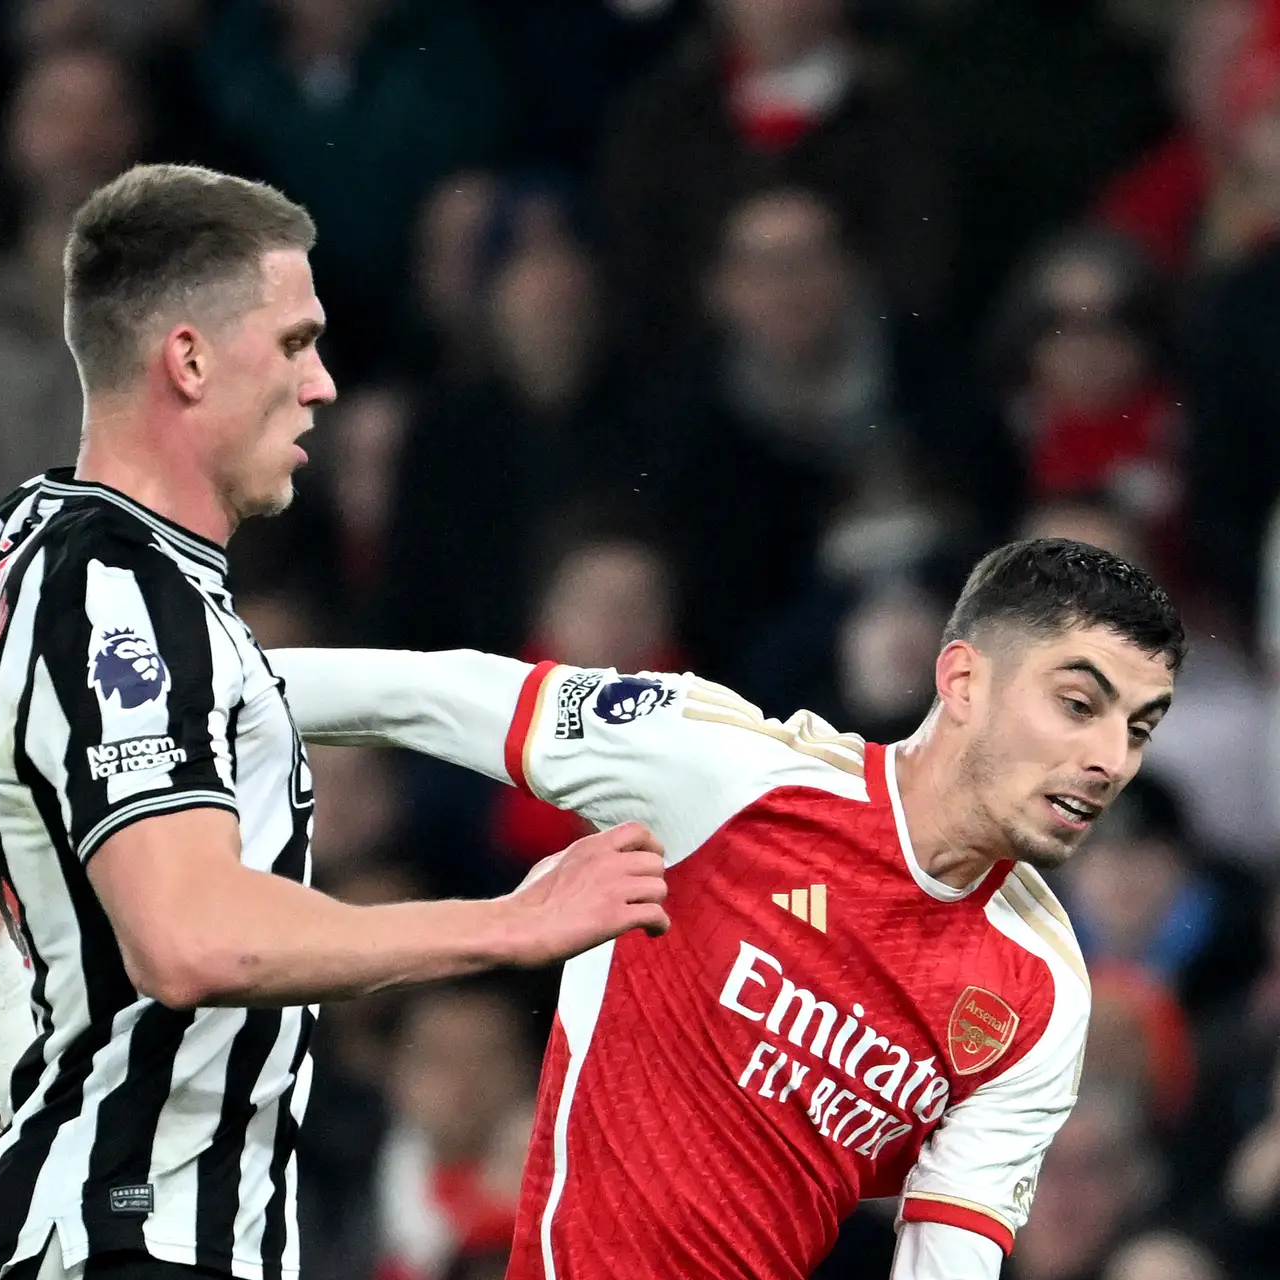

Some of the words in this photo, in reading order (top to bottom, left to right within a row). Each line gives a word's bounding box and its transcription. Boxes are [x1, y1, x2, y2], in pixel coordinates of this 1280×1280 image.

[554, 681, 576, 739] racism
[568, 685, 590, 729] room
[86, 744, 119, 764] No
[120, 737, 175, 757] room
[90, 760, 119, 780] for
[121, 748, 187, 772] racism
[719, 940, 950, 1124] Emirate
[965, 1000, 1007, 1034] Arsenal
[737, 1040, 811, 1103] FLY
[806, 1076, 913, 1160] BETTER
